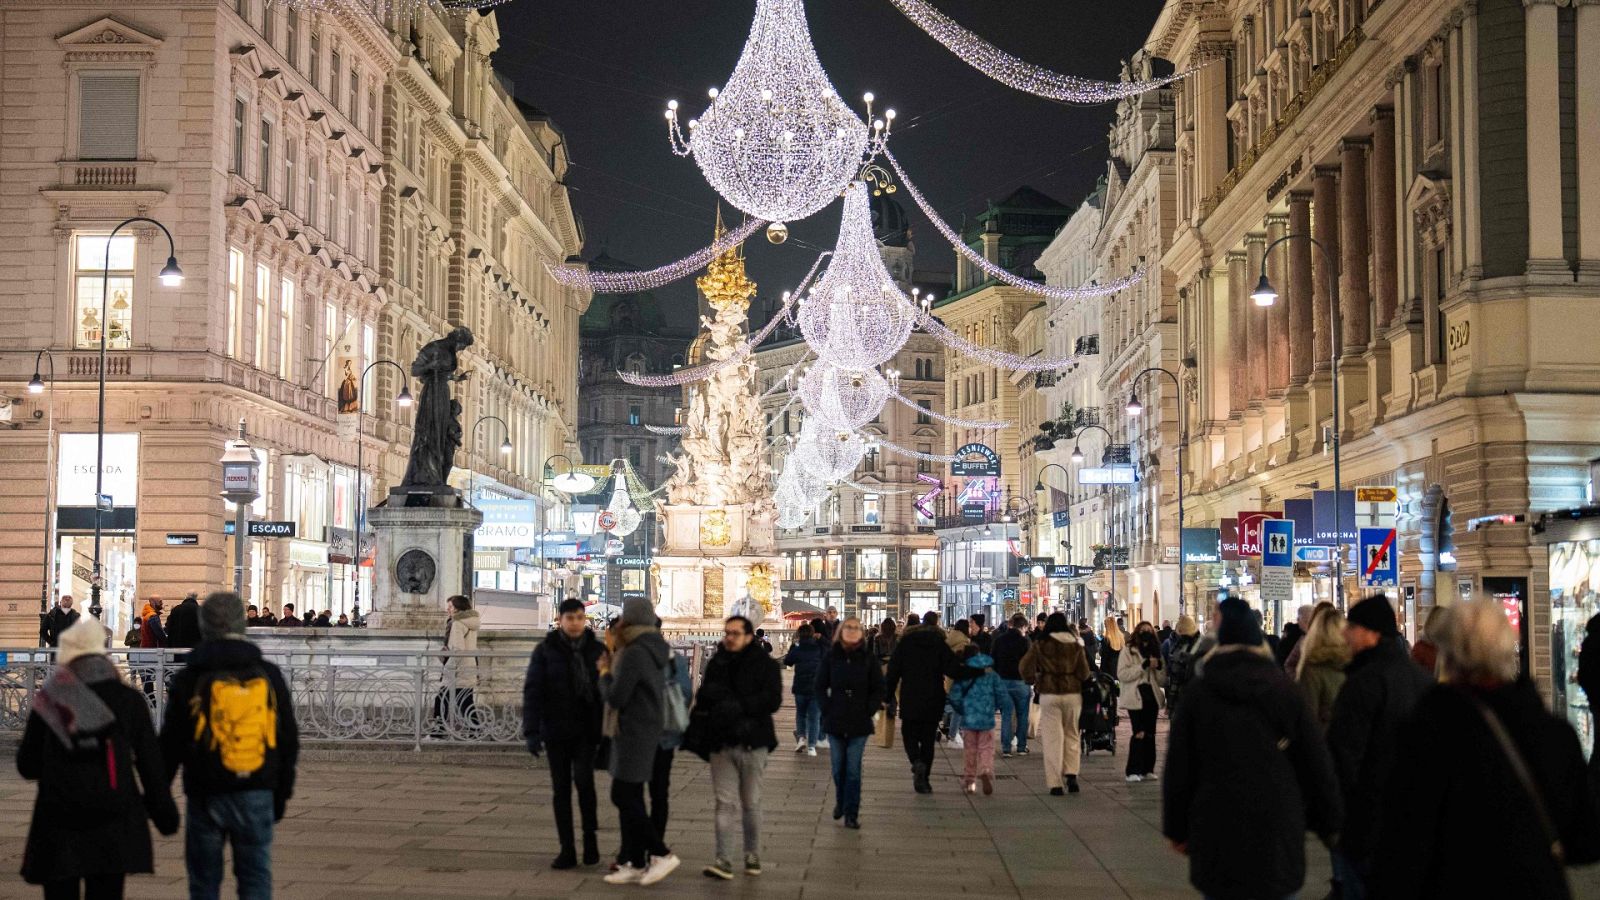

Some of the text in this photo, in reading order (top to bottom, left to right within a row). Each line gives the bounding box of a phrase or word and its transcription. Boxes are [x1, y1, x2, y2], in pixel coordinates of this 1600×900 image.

[74, 465, 122, 474] ESCDA
[566, 466, 605, 474] VERSACE
[252, 523, 291, 534] ESCADA
